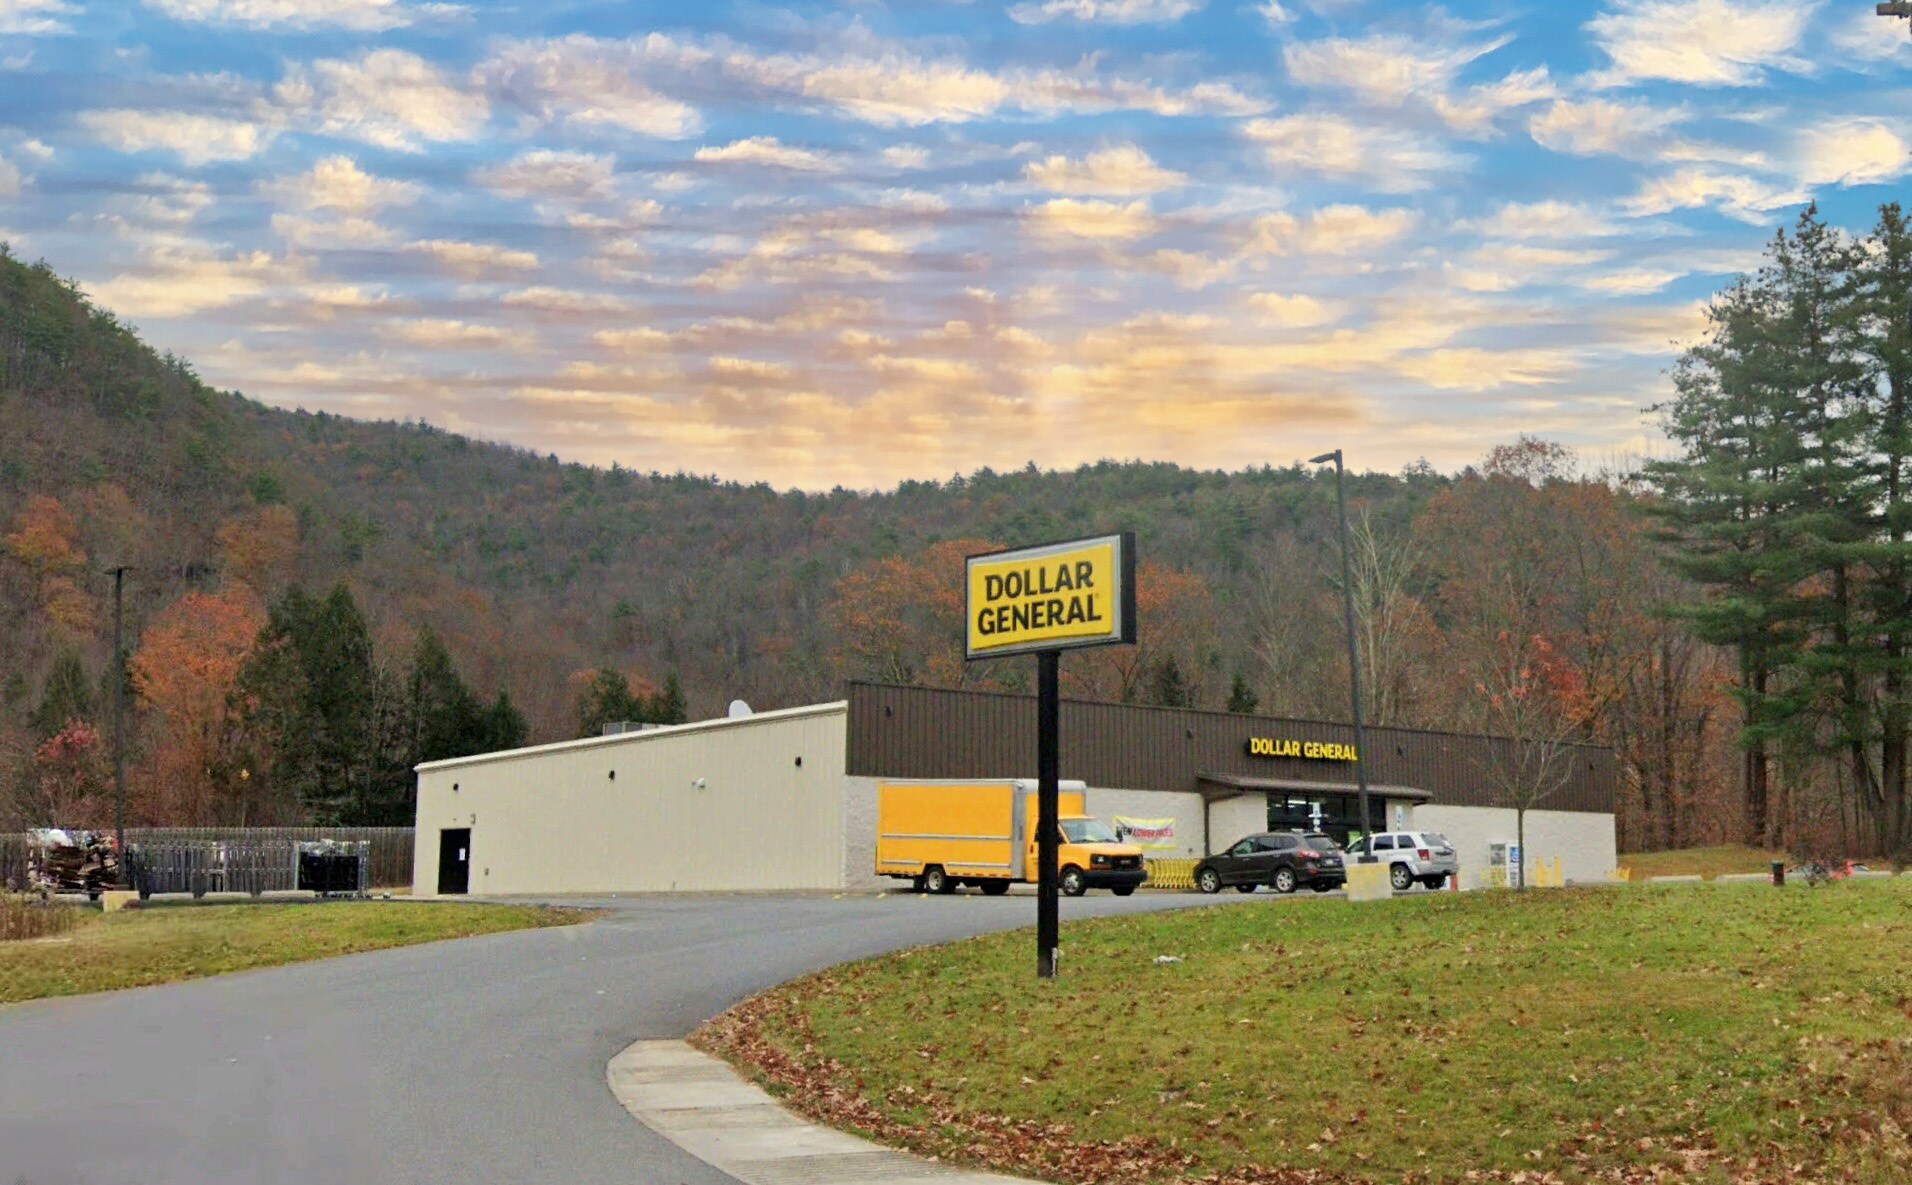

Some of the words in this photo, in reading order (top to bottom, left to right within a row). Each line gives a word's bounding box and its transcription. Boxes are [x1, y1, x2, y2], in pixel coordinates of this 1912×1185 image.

[985, 561, 1094, 601] DOLLAR
[978, 593, 1102, 635] GENERAL
[1251, 738, 1301, 757] DOLLAR
[1304, 741, 1358, 761] GENERAL
